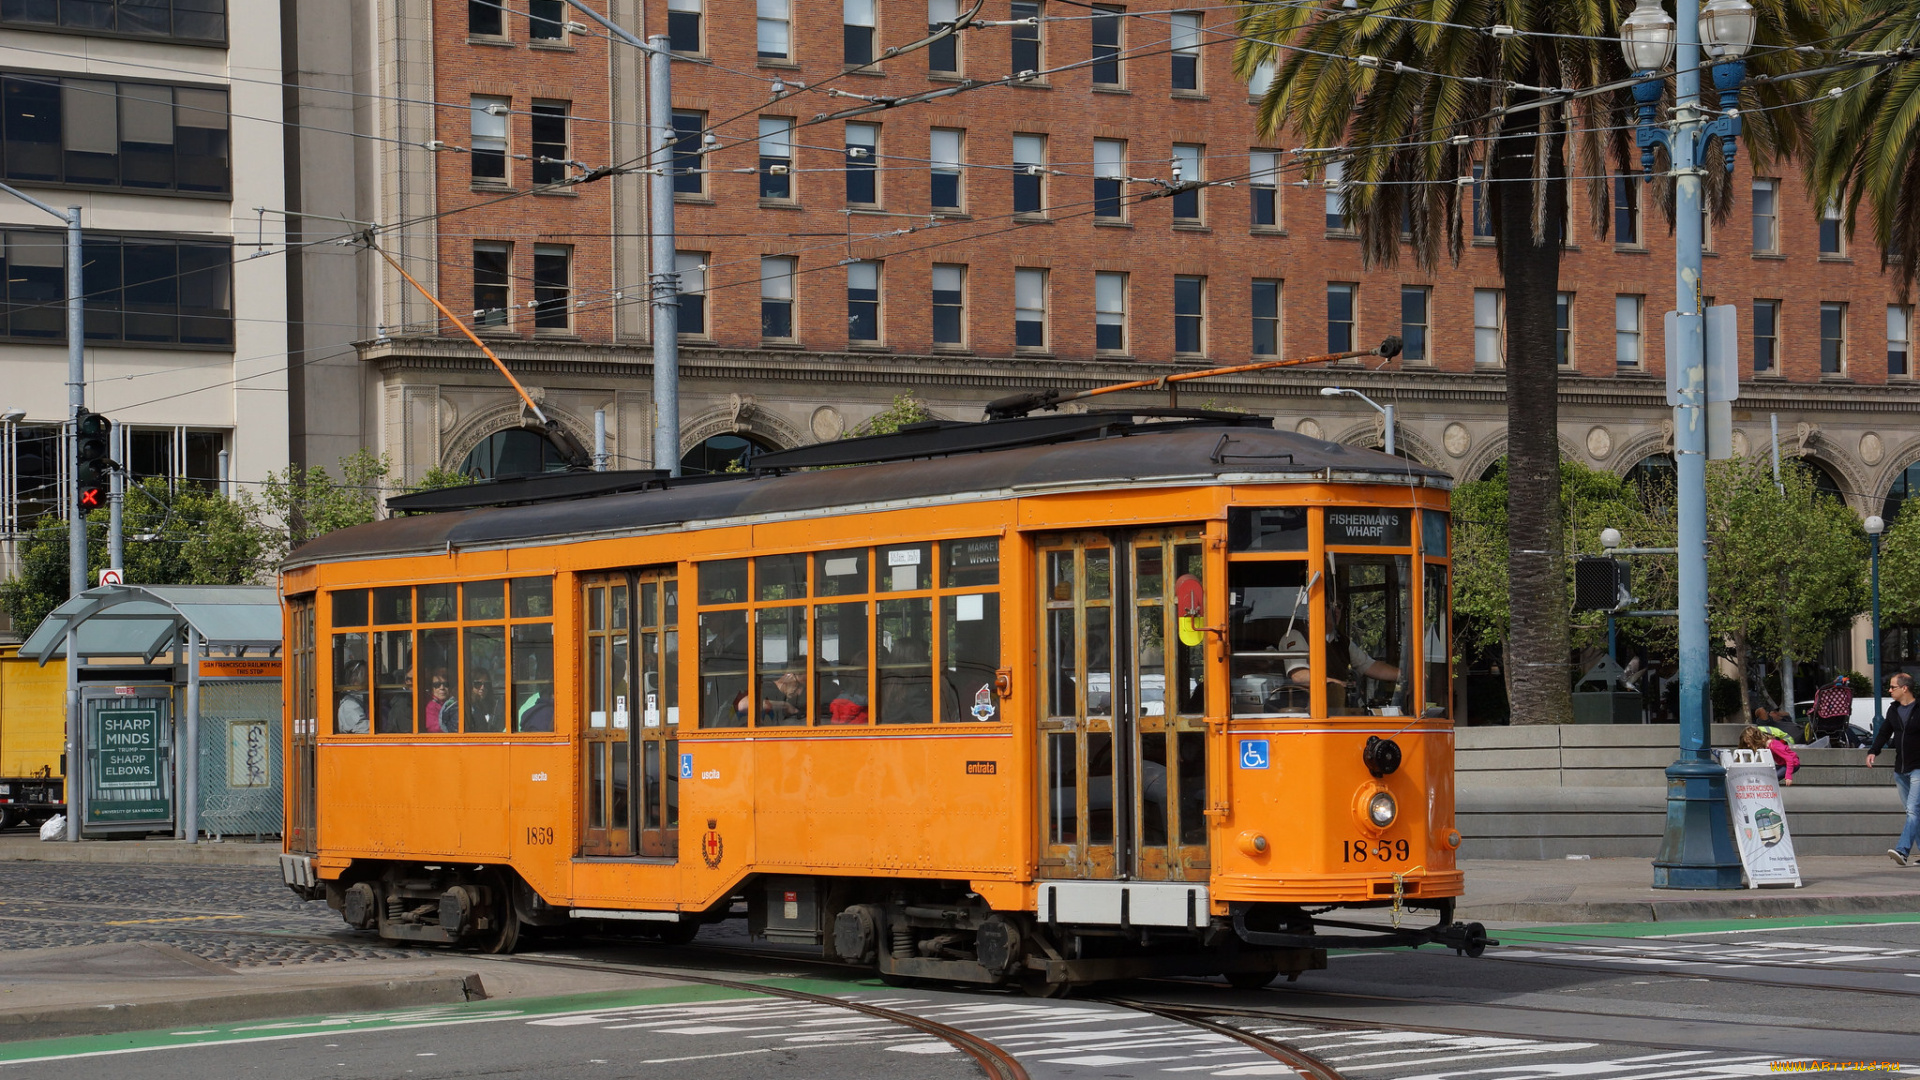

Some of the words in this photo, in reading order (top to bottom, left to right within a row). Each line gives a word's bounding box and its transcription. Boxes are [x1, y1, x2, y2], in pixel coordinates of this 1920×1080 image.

[1329, 514, 1399, 526] FISHERMAN'S
[1251, 509, 1284, 548] F
[1345, 526, 1384, 537] WHARF
[105, 719, 151, 731] SHARP
[106, 733, 150, 745] MINDS
[110, 755, 146, 764] SHARP
[105, 765, 153, 776] ELBOWS.
[967, 761, 995, 774] entrata
[1747, 784, 1774, 792] FRANCISCO
[1756, 791, 1778, 799] MUSEUM
[526, 827, 554, 846] 1859
